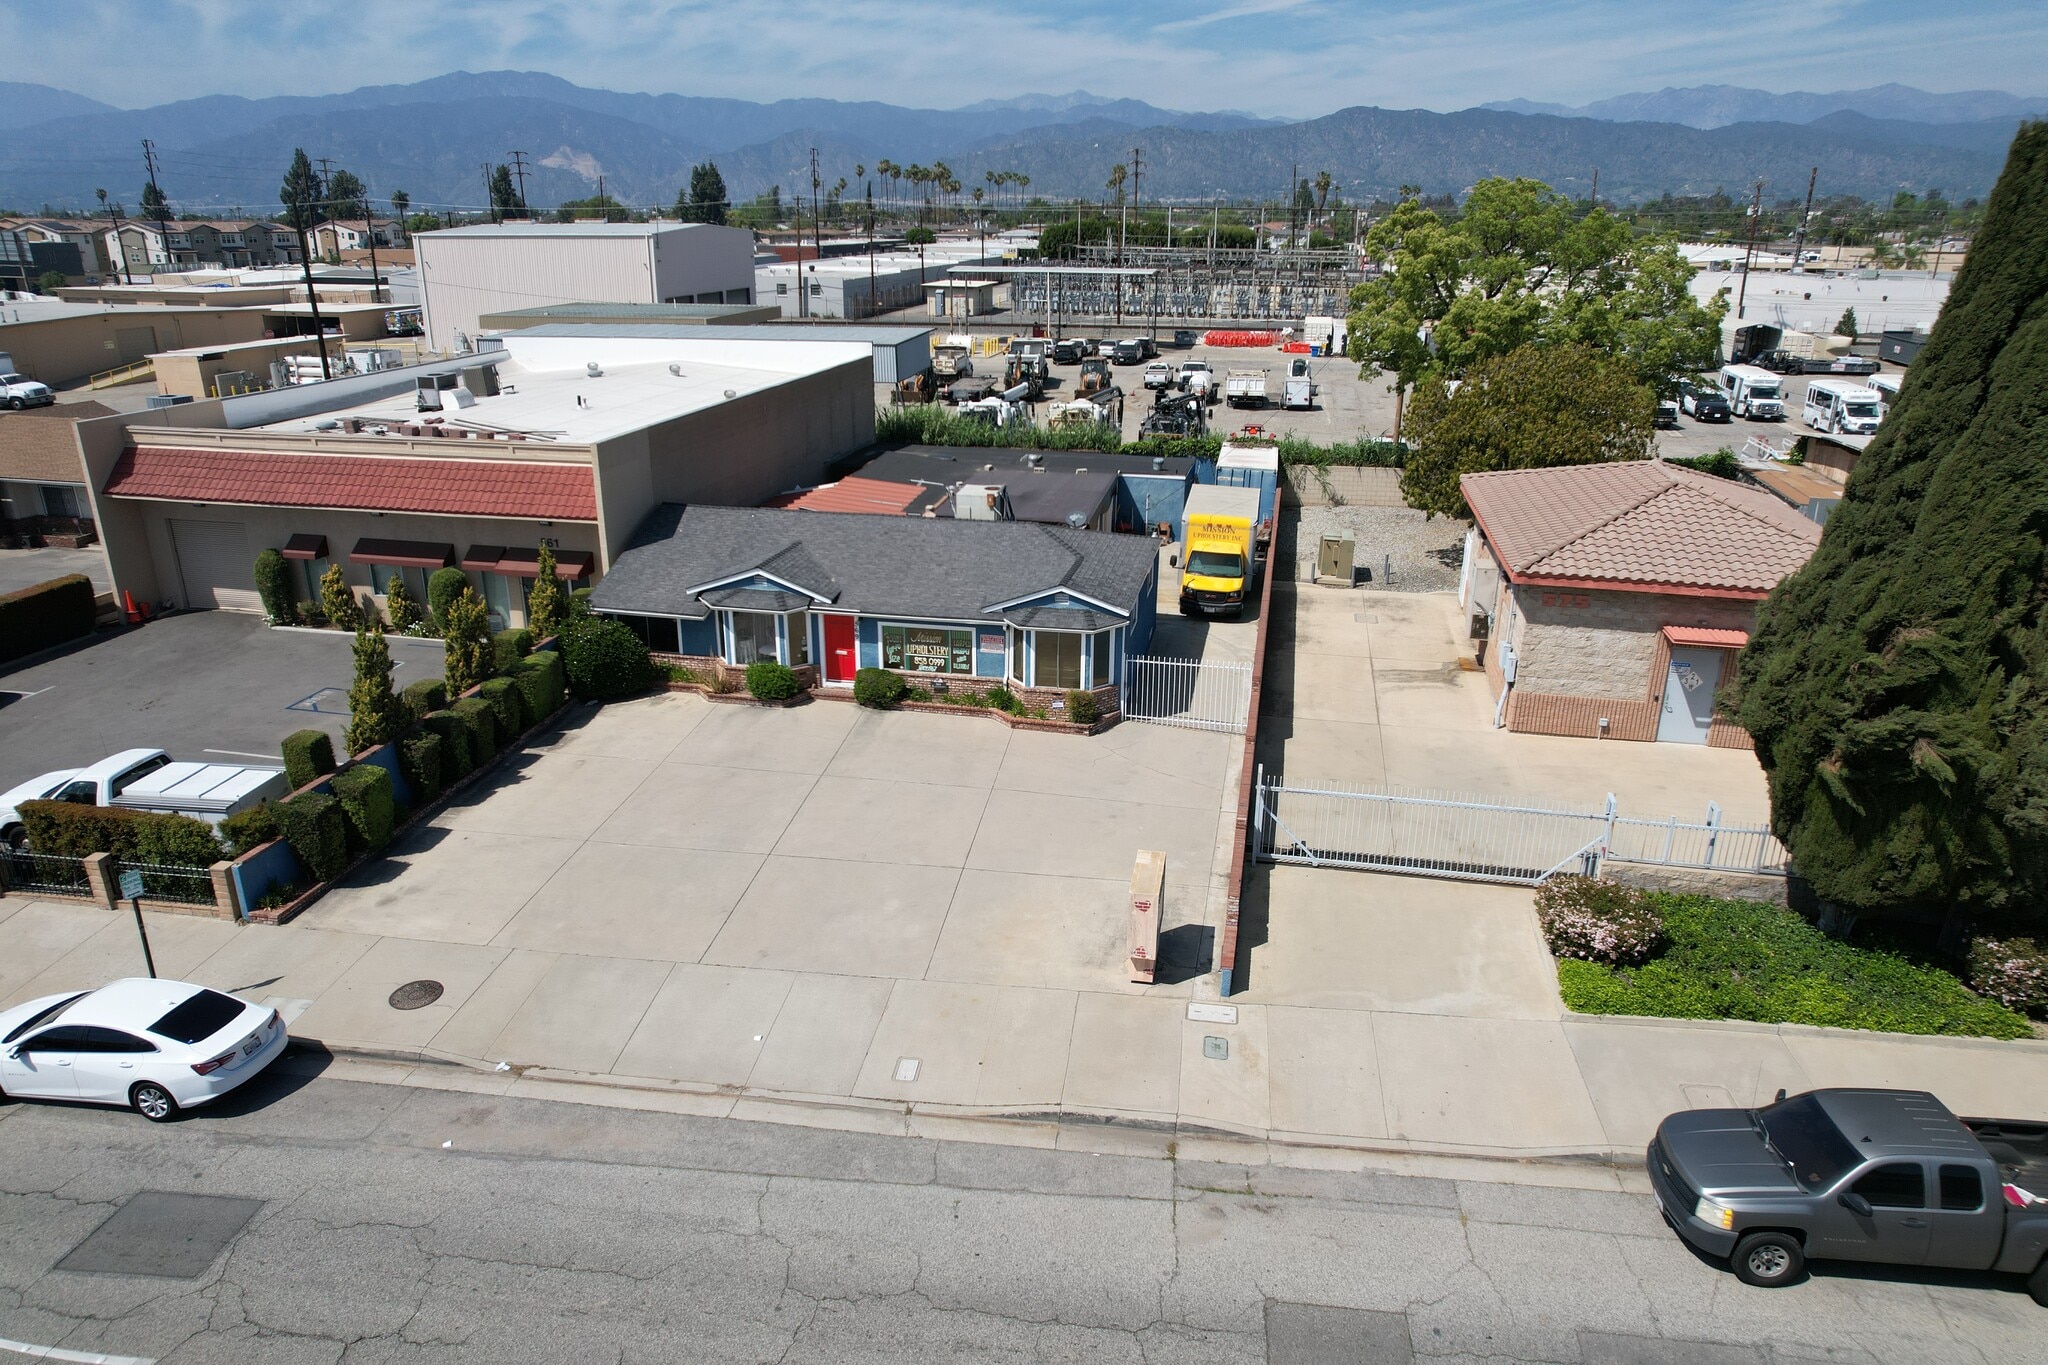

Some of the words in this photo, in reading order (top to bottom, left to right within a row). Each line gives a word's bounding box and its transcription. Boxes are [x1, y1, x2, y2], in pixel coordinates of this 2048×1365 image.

[1202, 525, 1236, 534] MISSION
[1193, 531, 1230, 540] UPHOLSTERY
[910, 631, 943, 643] Mission
[906, 643, 949, 656] UPHOLSTERY
